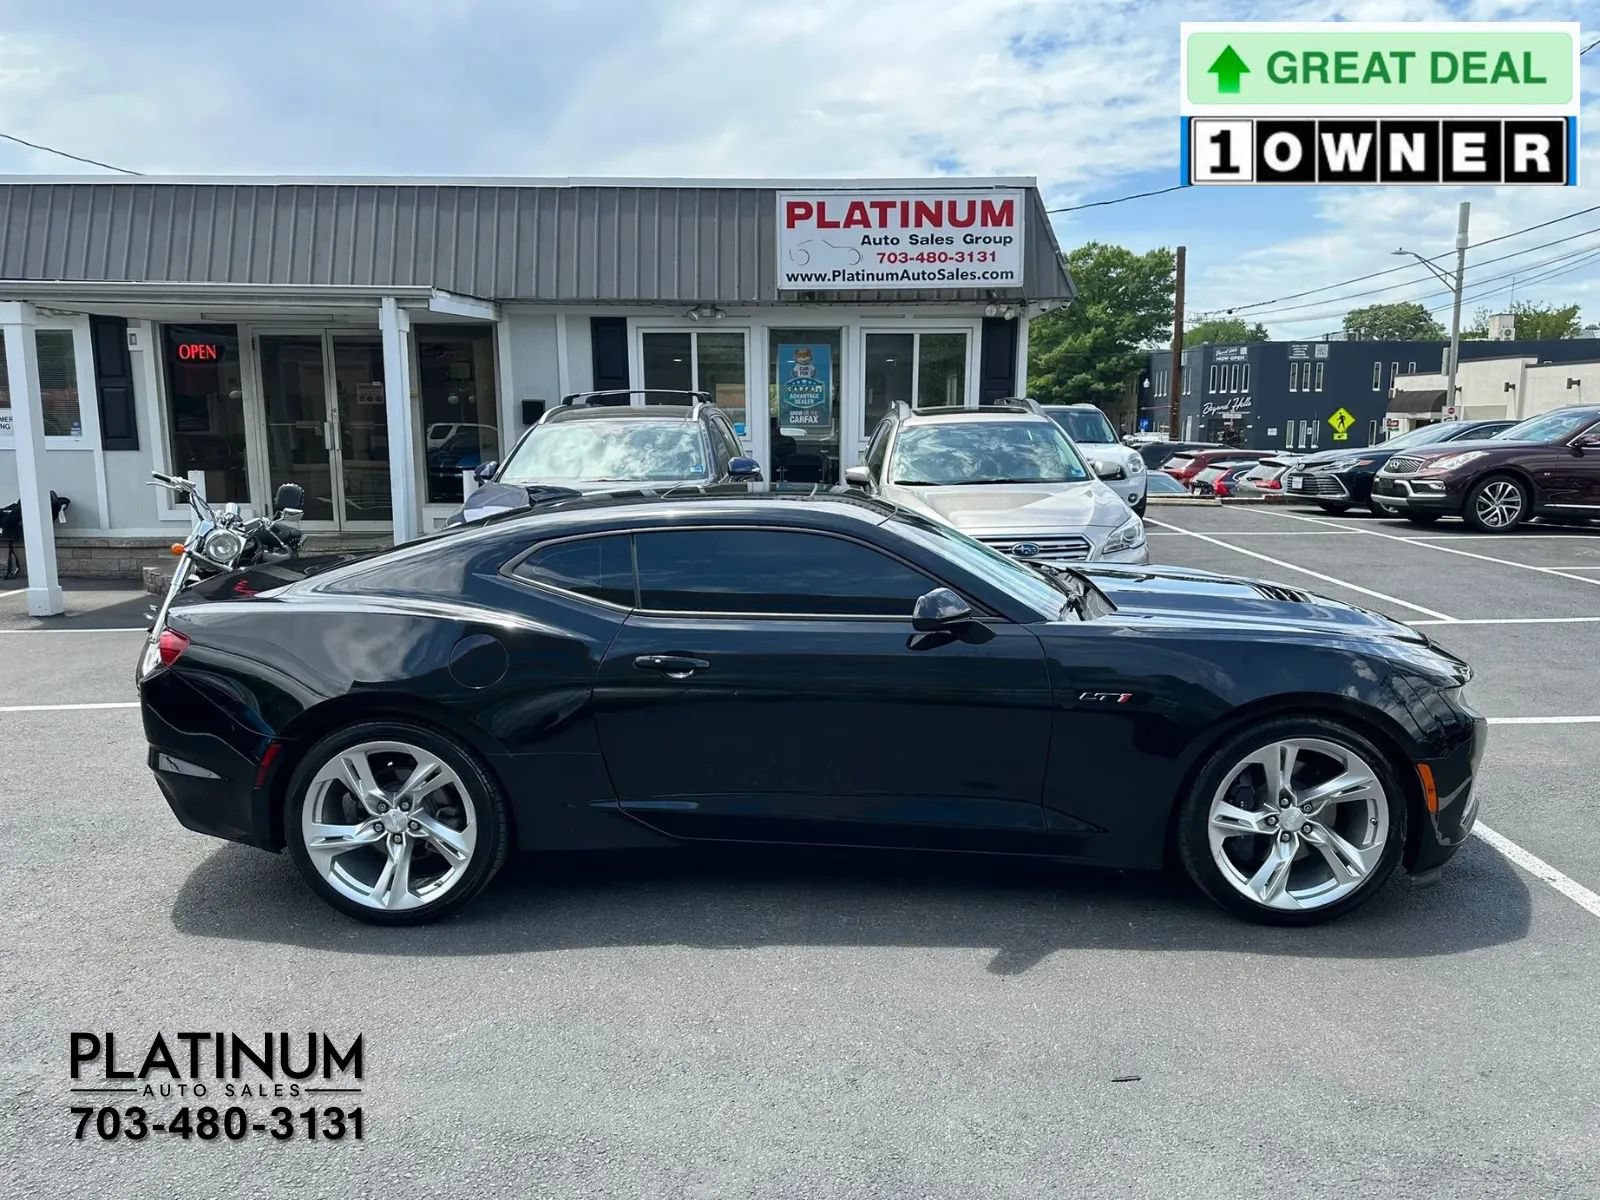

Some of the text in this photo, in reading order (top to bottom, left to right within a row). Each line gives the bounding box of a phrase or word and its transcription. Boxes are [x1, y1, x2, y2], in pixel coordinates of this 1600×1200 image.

[785, 199, 1014, 229] PLATINUM
[861, 233, 1013, 247] Auto Sales Group
[876, 251, 997, 264] 703-480-3131
[786, 268, 1014, 283] www.PlatinumAutoSales.com
[179, 343, 217, 360] OPEN
[789, 415, 819, 424] CARFAX
[1079, 692, 1133, 703] LT1
